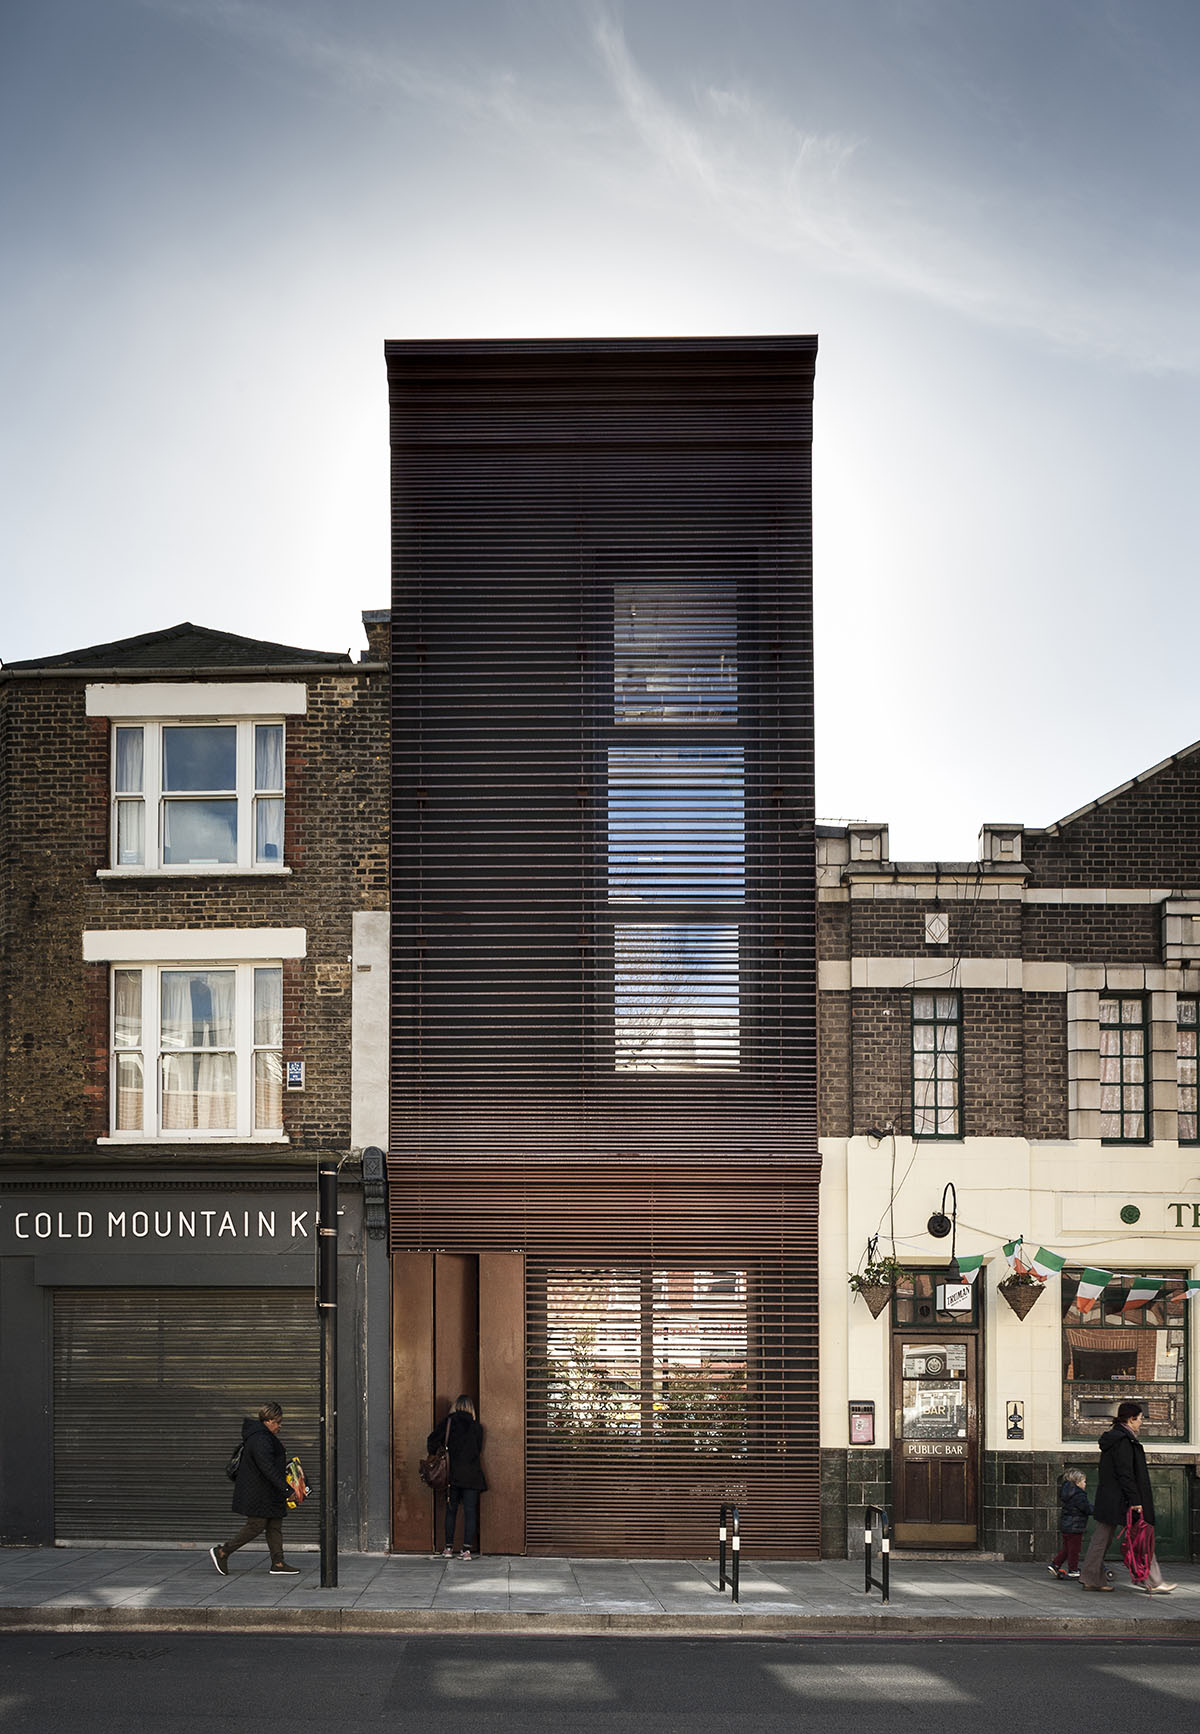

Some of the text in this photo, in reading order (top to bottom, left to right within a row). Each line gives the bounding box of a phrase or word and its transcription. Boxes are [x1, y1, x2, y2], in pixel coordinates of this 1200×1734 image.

[15, 1211, 93, 1238] COLD
[108, 1211, 276, 1238] MOUNTAIN
[922, 1405, 946, 1415] BAR
[908, 1445, 963, 1455] PUBLIC BAR
